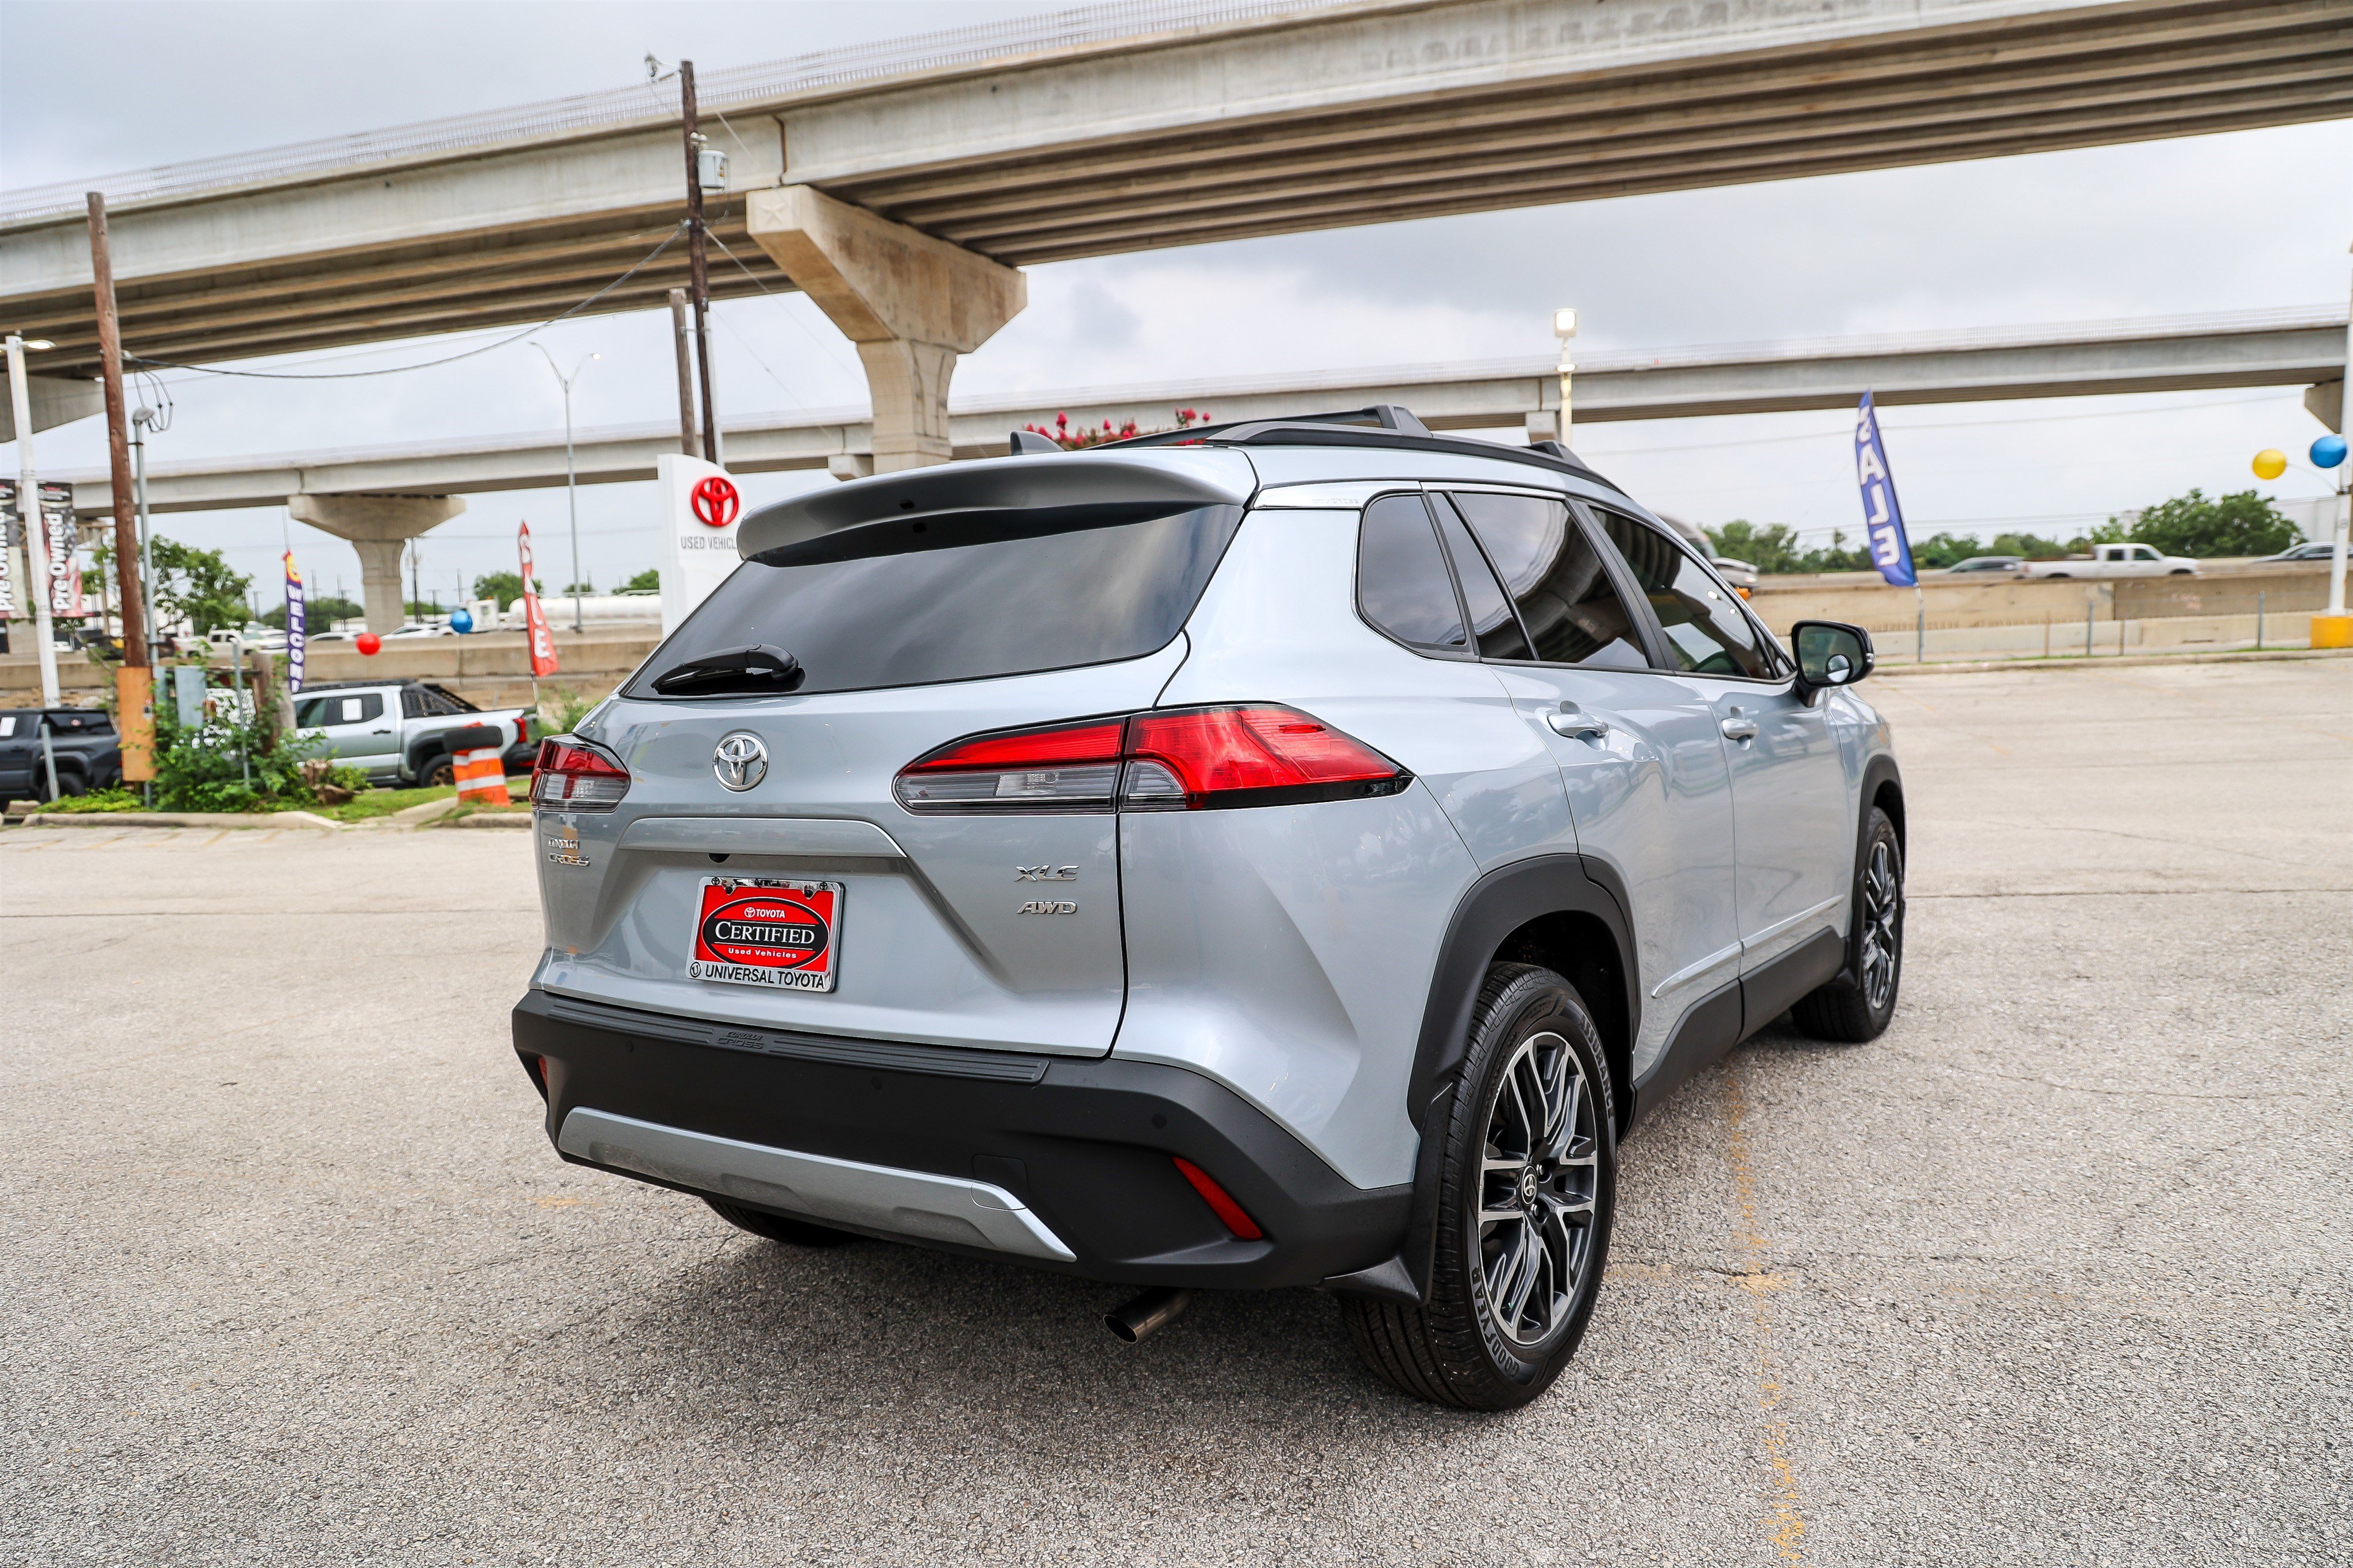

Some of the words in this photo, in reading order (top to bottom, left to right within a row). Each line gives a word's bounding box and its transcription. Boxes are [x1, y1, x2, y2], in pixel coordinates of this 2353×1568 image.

[44, 512, 68, 576] Owned
[680, 536, 705, 550] USED
[707, 536, 737, 550] VEHICL
[52, 579, 71, 611] Pre
[1013, 865, 1079, 882] XLE
[755, 909, 786, 918] TOYOTA
[1016, 901, 1078, 914] AWD
[715, 921, 815, 944] CERTIFIED
[728, 948, 751, 956] Used
[755, 949, 797, 959] Vehicles
[705, 964, 774, 984] UNIVERSAL
[777, 970, 825, 989] TOYOTA
[717, 1037, 765, 1049] CROSS
[1579, 1014, 1615, 1120] ASSURANCE
[1472, 1265, 1520, 1377] GOODYEAR
